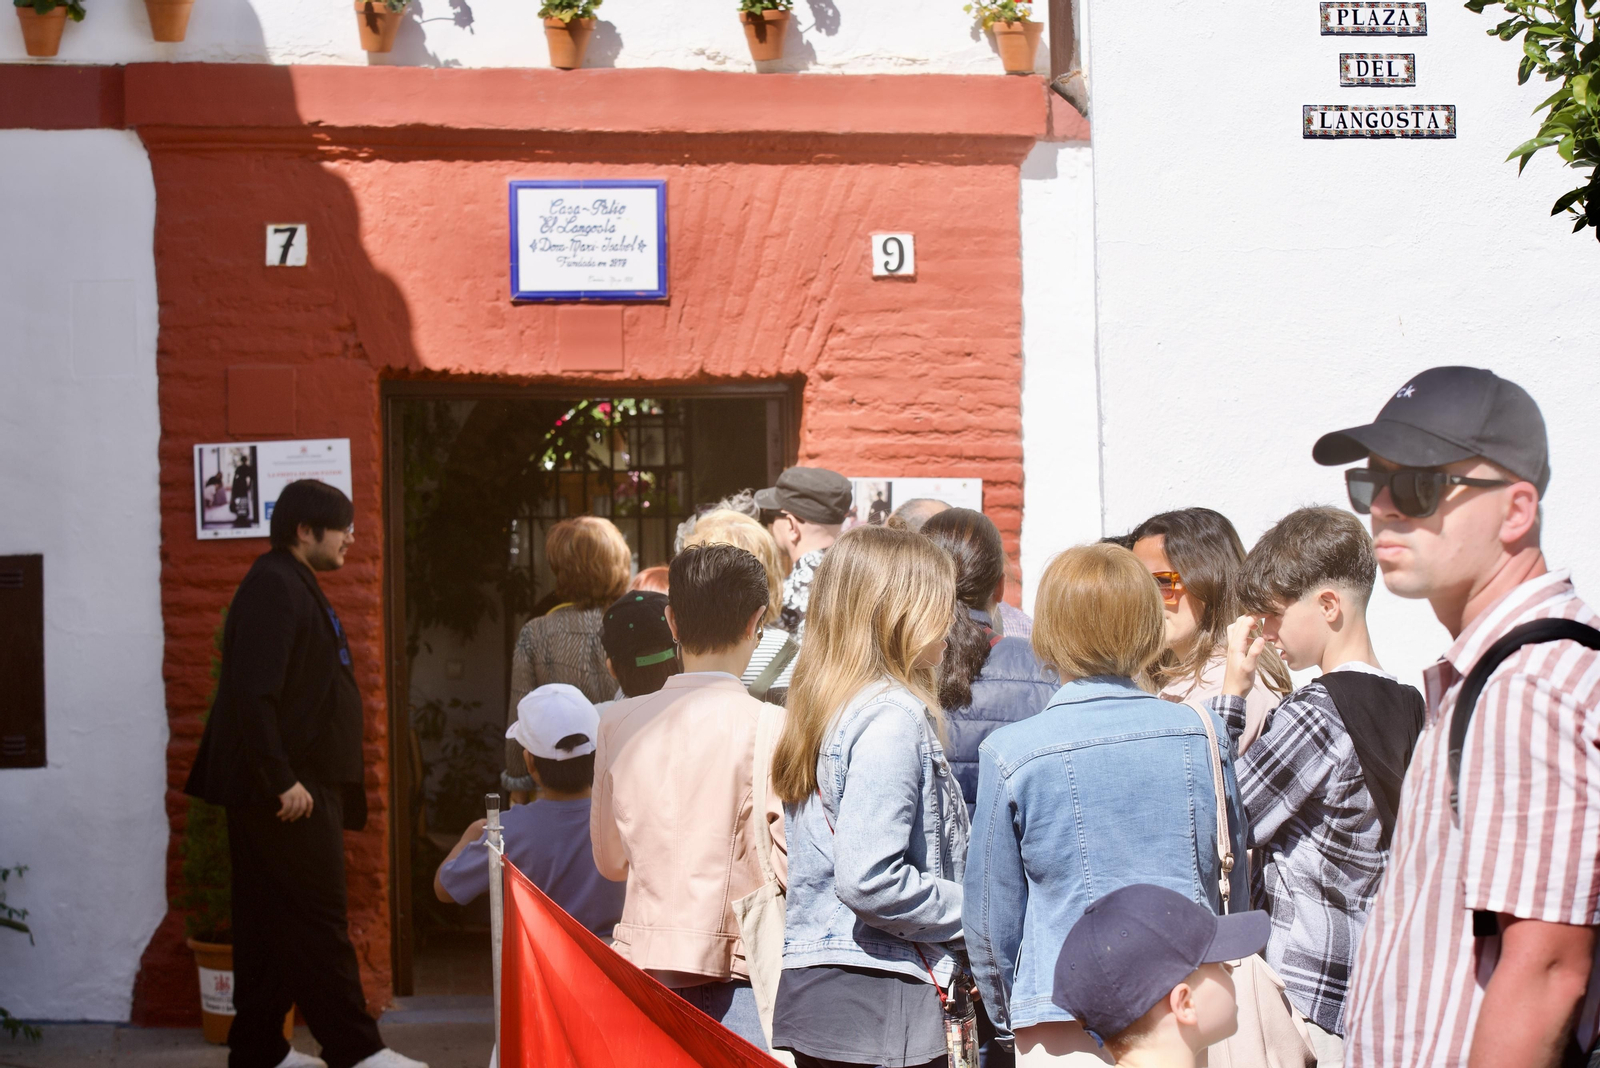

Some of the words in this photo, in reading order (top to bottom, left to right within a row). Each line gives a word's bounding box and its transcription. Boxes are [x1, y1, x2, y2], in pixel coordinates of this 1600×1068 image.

[1337, 9, 1410, 26] PLAZA
[1356, 60, 1399, 77] DEL
[1319, 112, 1439, 129] LANGOSTA
[274, 226, 298, 265] 7
[882, 236, 905, 273] 9
